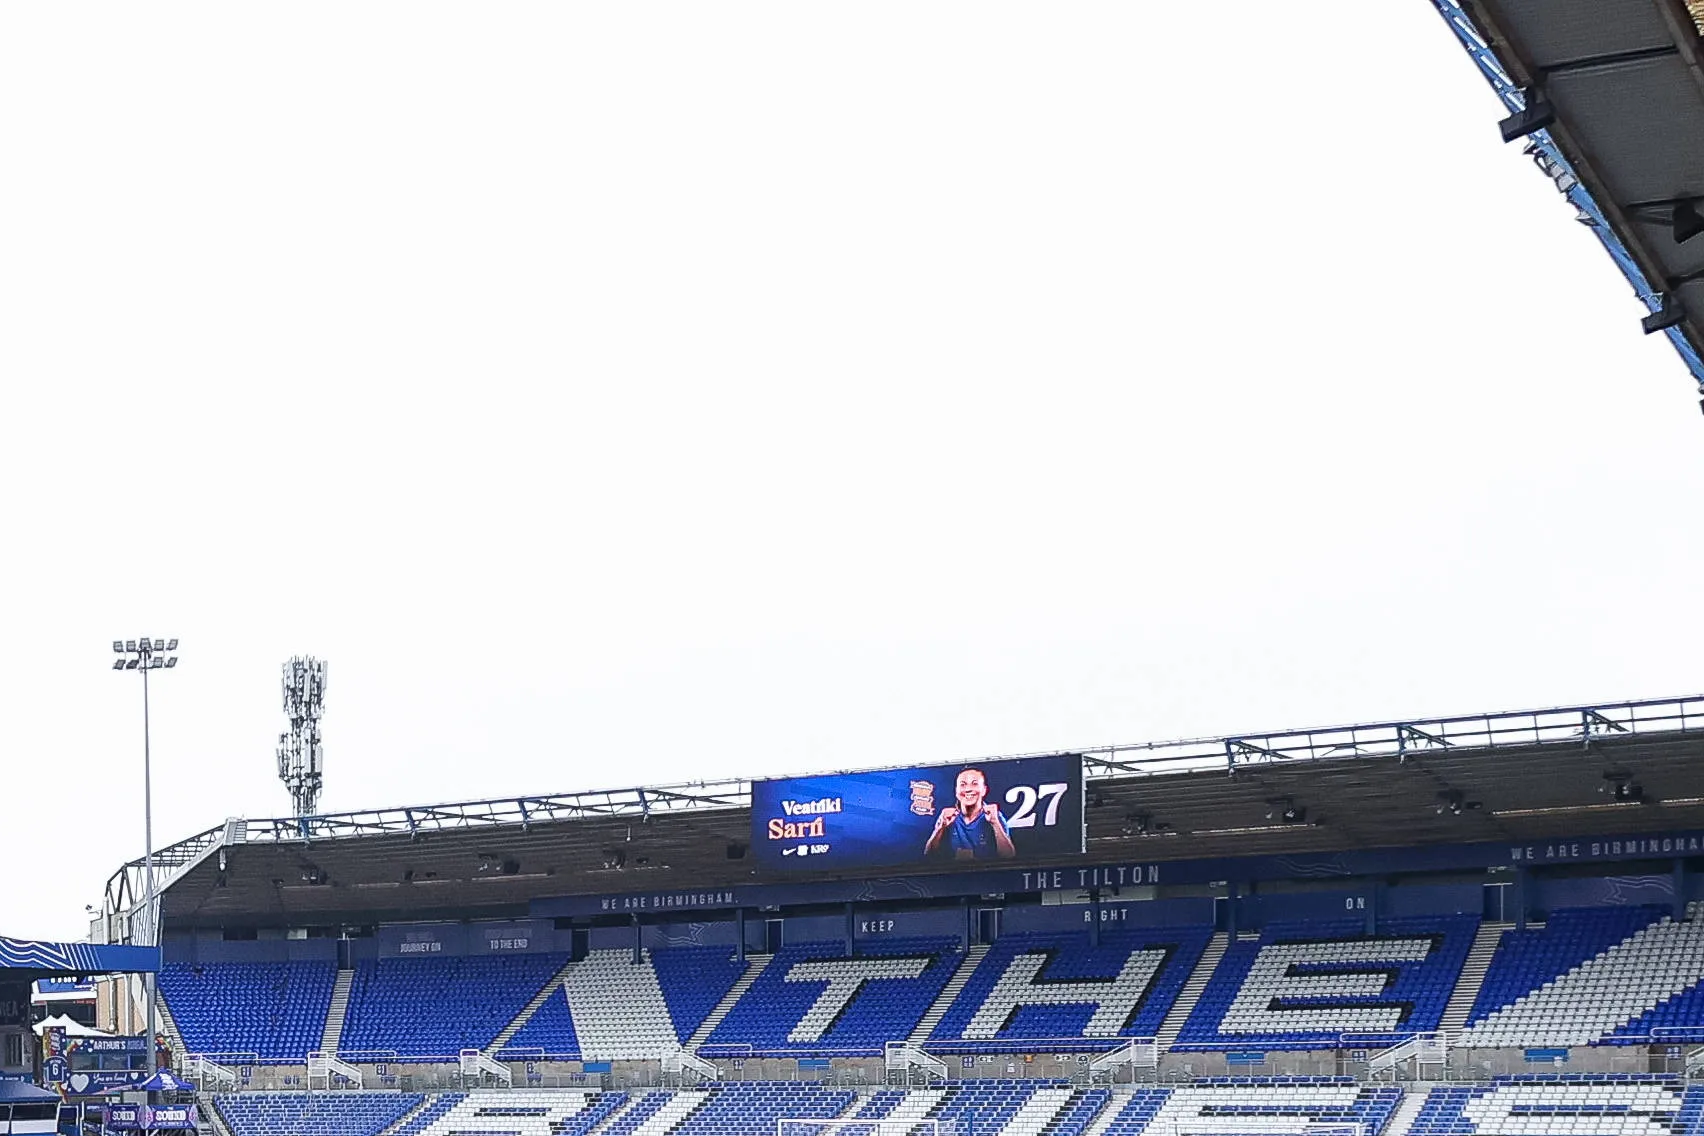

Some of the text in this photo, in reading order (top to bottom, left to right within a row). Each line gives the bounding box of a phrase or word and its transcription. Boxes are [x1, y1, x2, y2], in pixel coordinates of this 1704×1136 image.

[1005, 783, 1067, 828] 27
[1511, 836, 1704, 860] WE ARE BIRMINGHA
[1023, 866, 1159, 890] THE TILTON
[602, 899, 617, 909] WE
[624, 897, 646, 908] ARE
[1346, 898, 1364, 909] ON
[1084, 909, 1127, 922] RGHT
[861, 921, 894, 932] KEEP
